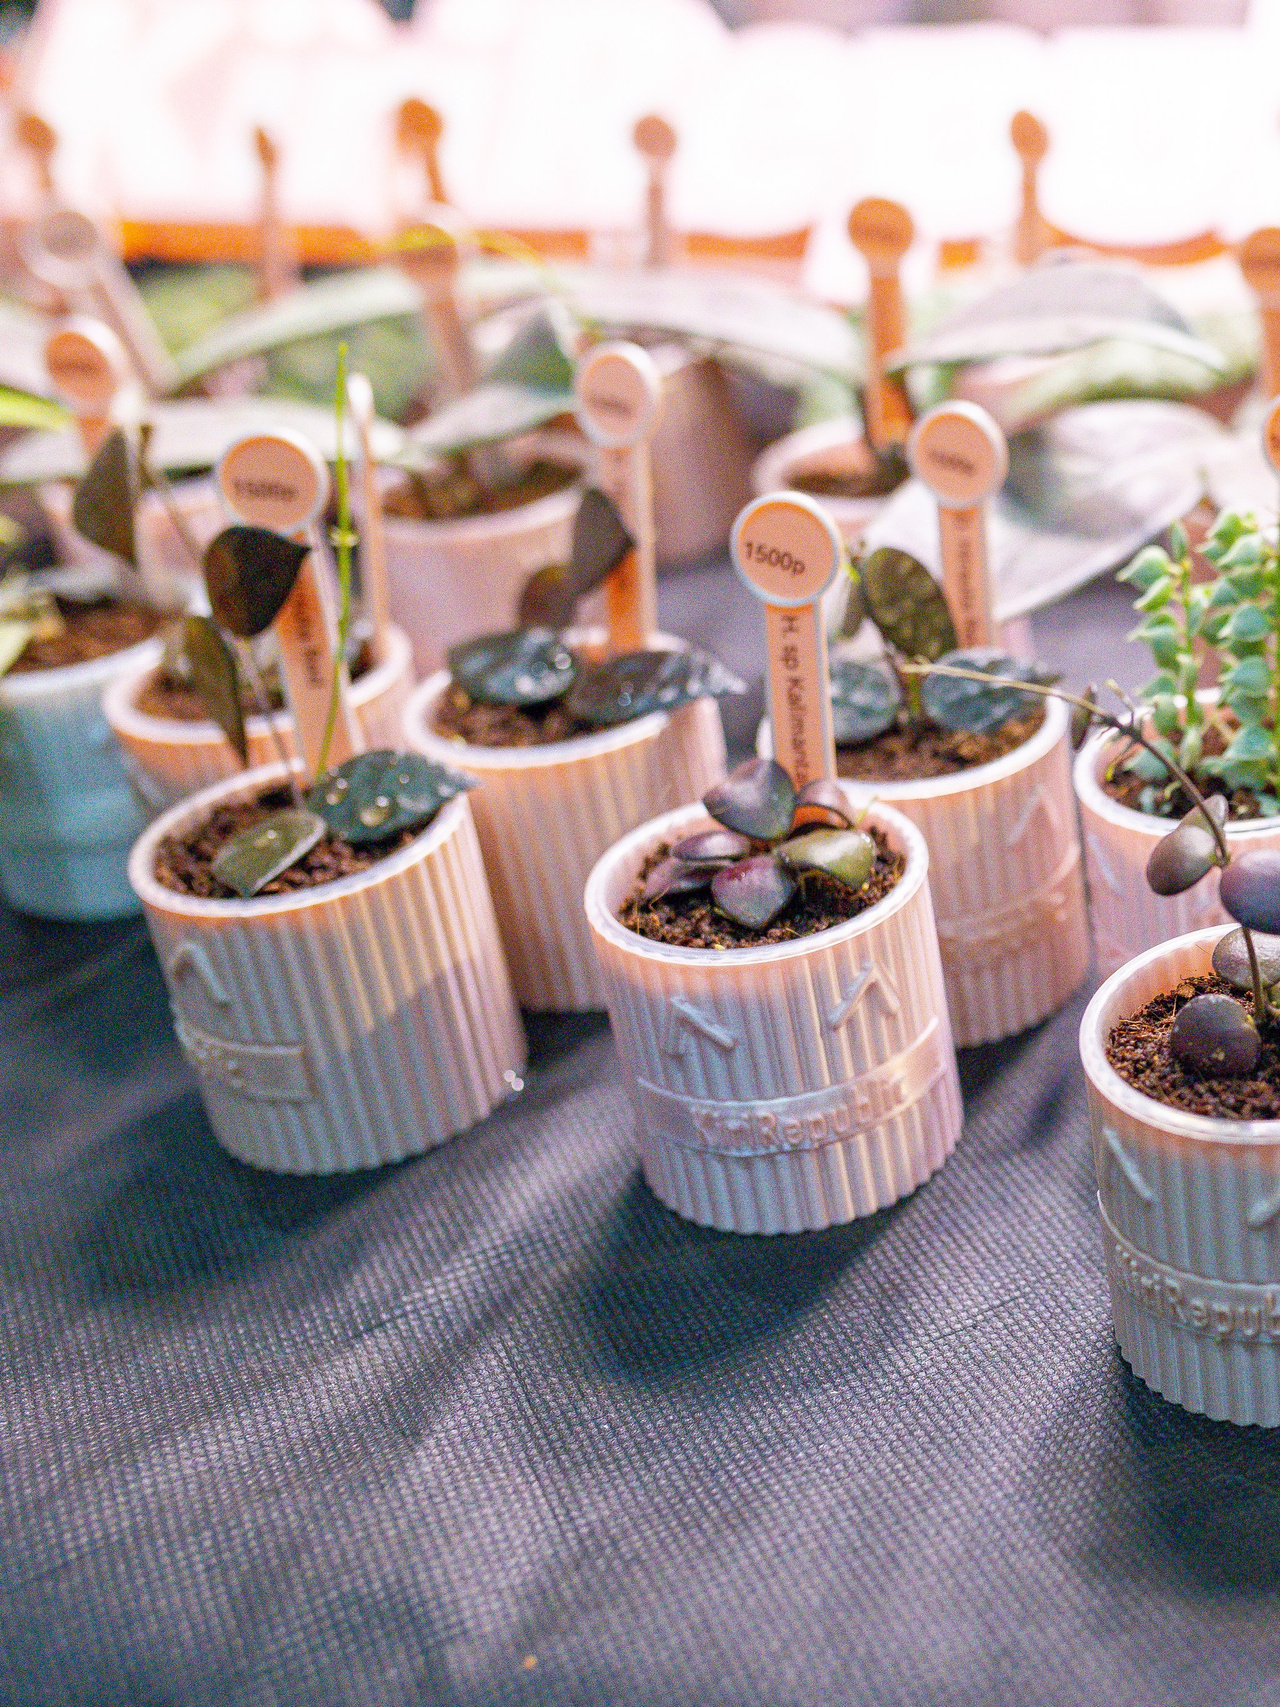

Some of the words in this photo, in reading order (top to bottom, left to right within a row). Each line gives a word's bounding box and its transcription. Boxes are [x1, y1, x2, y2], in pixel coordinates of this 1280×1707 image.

[744, 540, 806, 576] 1500p
[779, 613, 800, 639] H.
[779, 645, 801, 672] sp
[786, 676, 810, 790] Kalimanta
